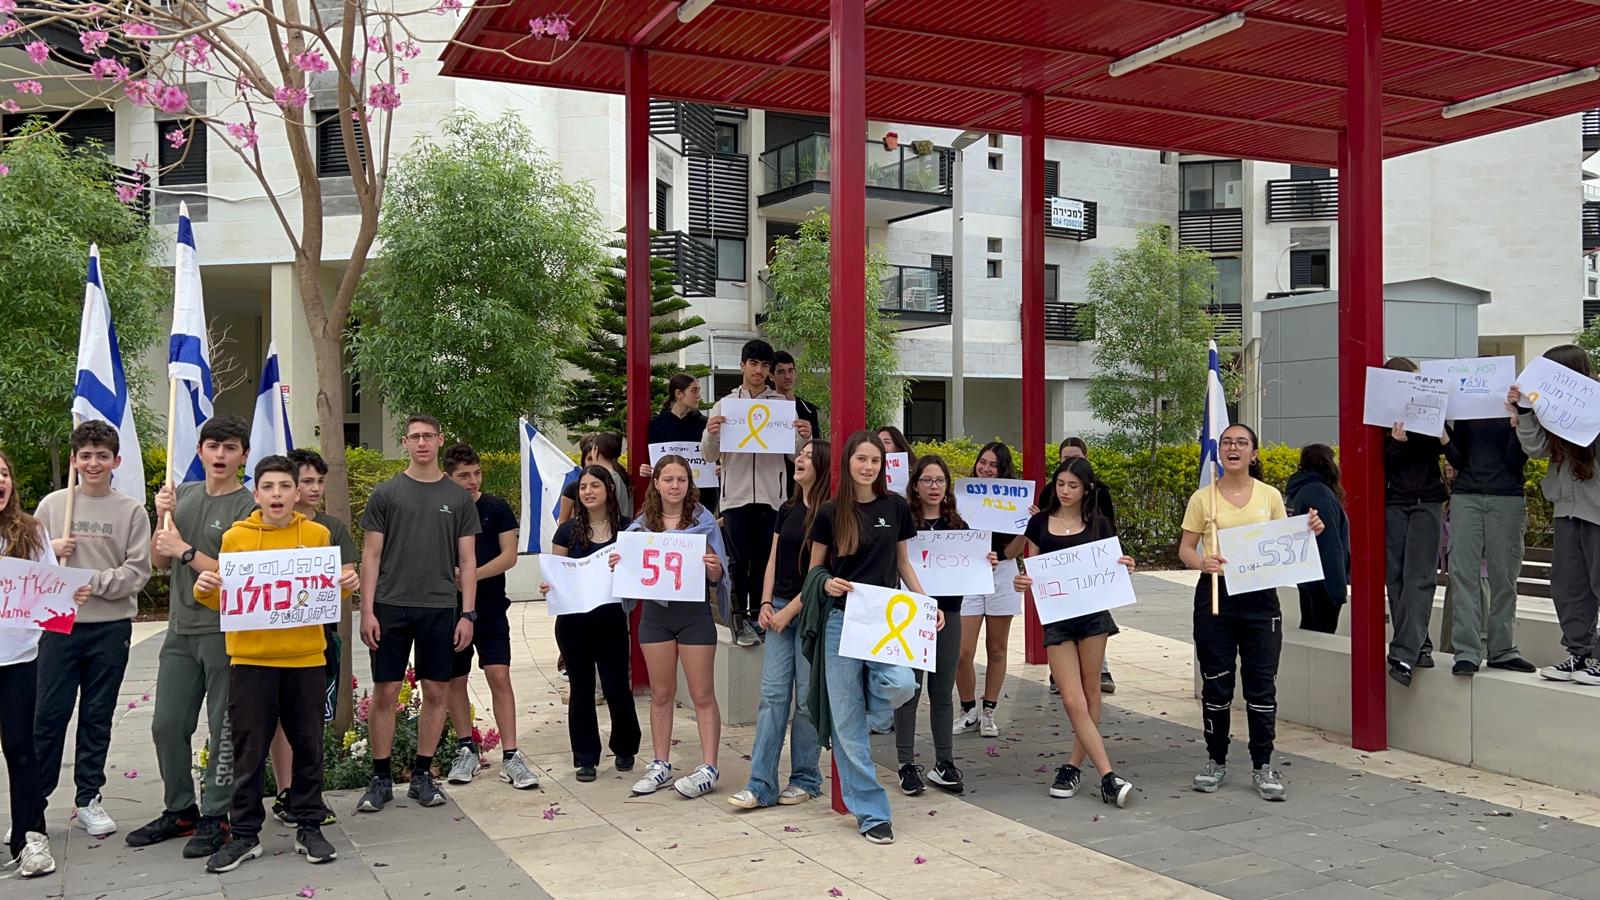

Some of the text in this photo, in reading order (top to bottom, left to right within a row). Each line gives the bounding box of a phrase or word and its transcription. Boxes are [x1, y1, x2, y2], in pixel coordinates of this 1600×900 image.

[1053, 207, 1083, 219] למכירה
[966, 483, 1029, 498] מחכים לכם
[945, 532, 987, 542] מחזירים
[1037, 544, 1109, 570] אין אופציה
[1258, 531, 1310, 567] 537
[224, 561, 253, 577] של
[640, 549, 683, 591] 59
[1068, 567, 1115, 591] למועד
[295, 573, 336, 590] אחד
[221, 576, 292, 616] כולנו
